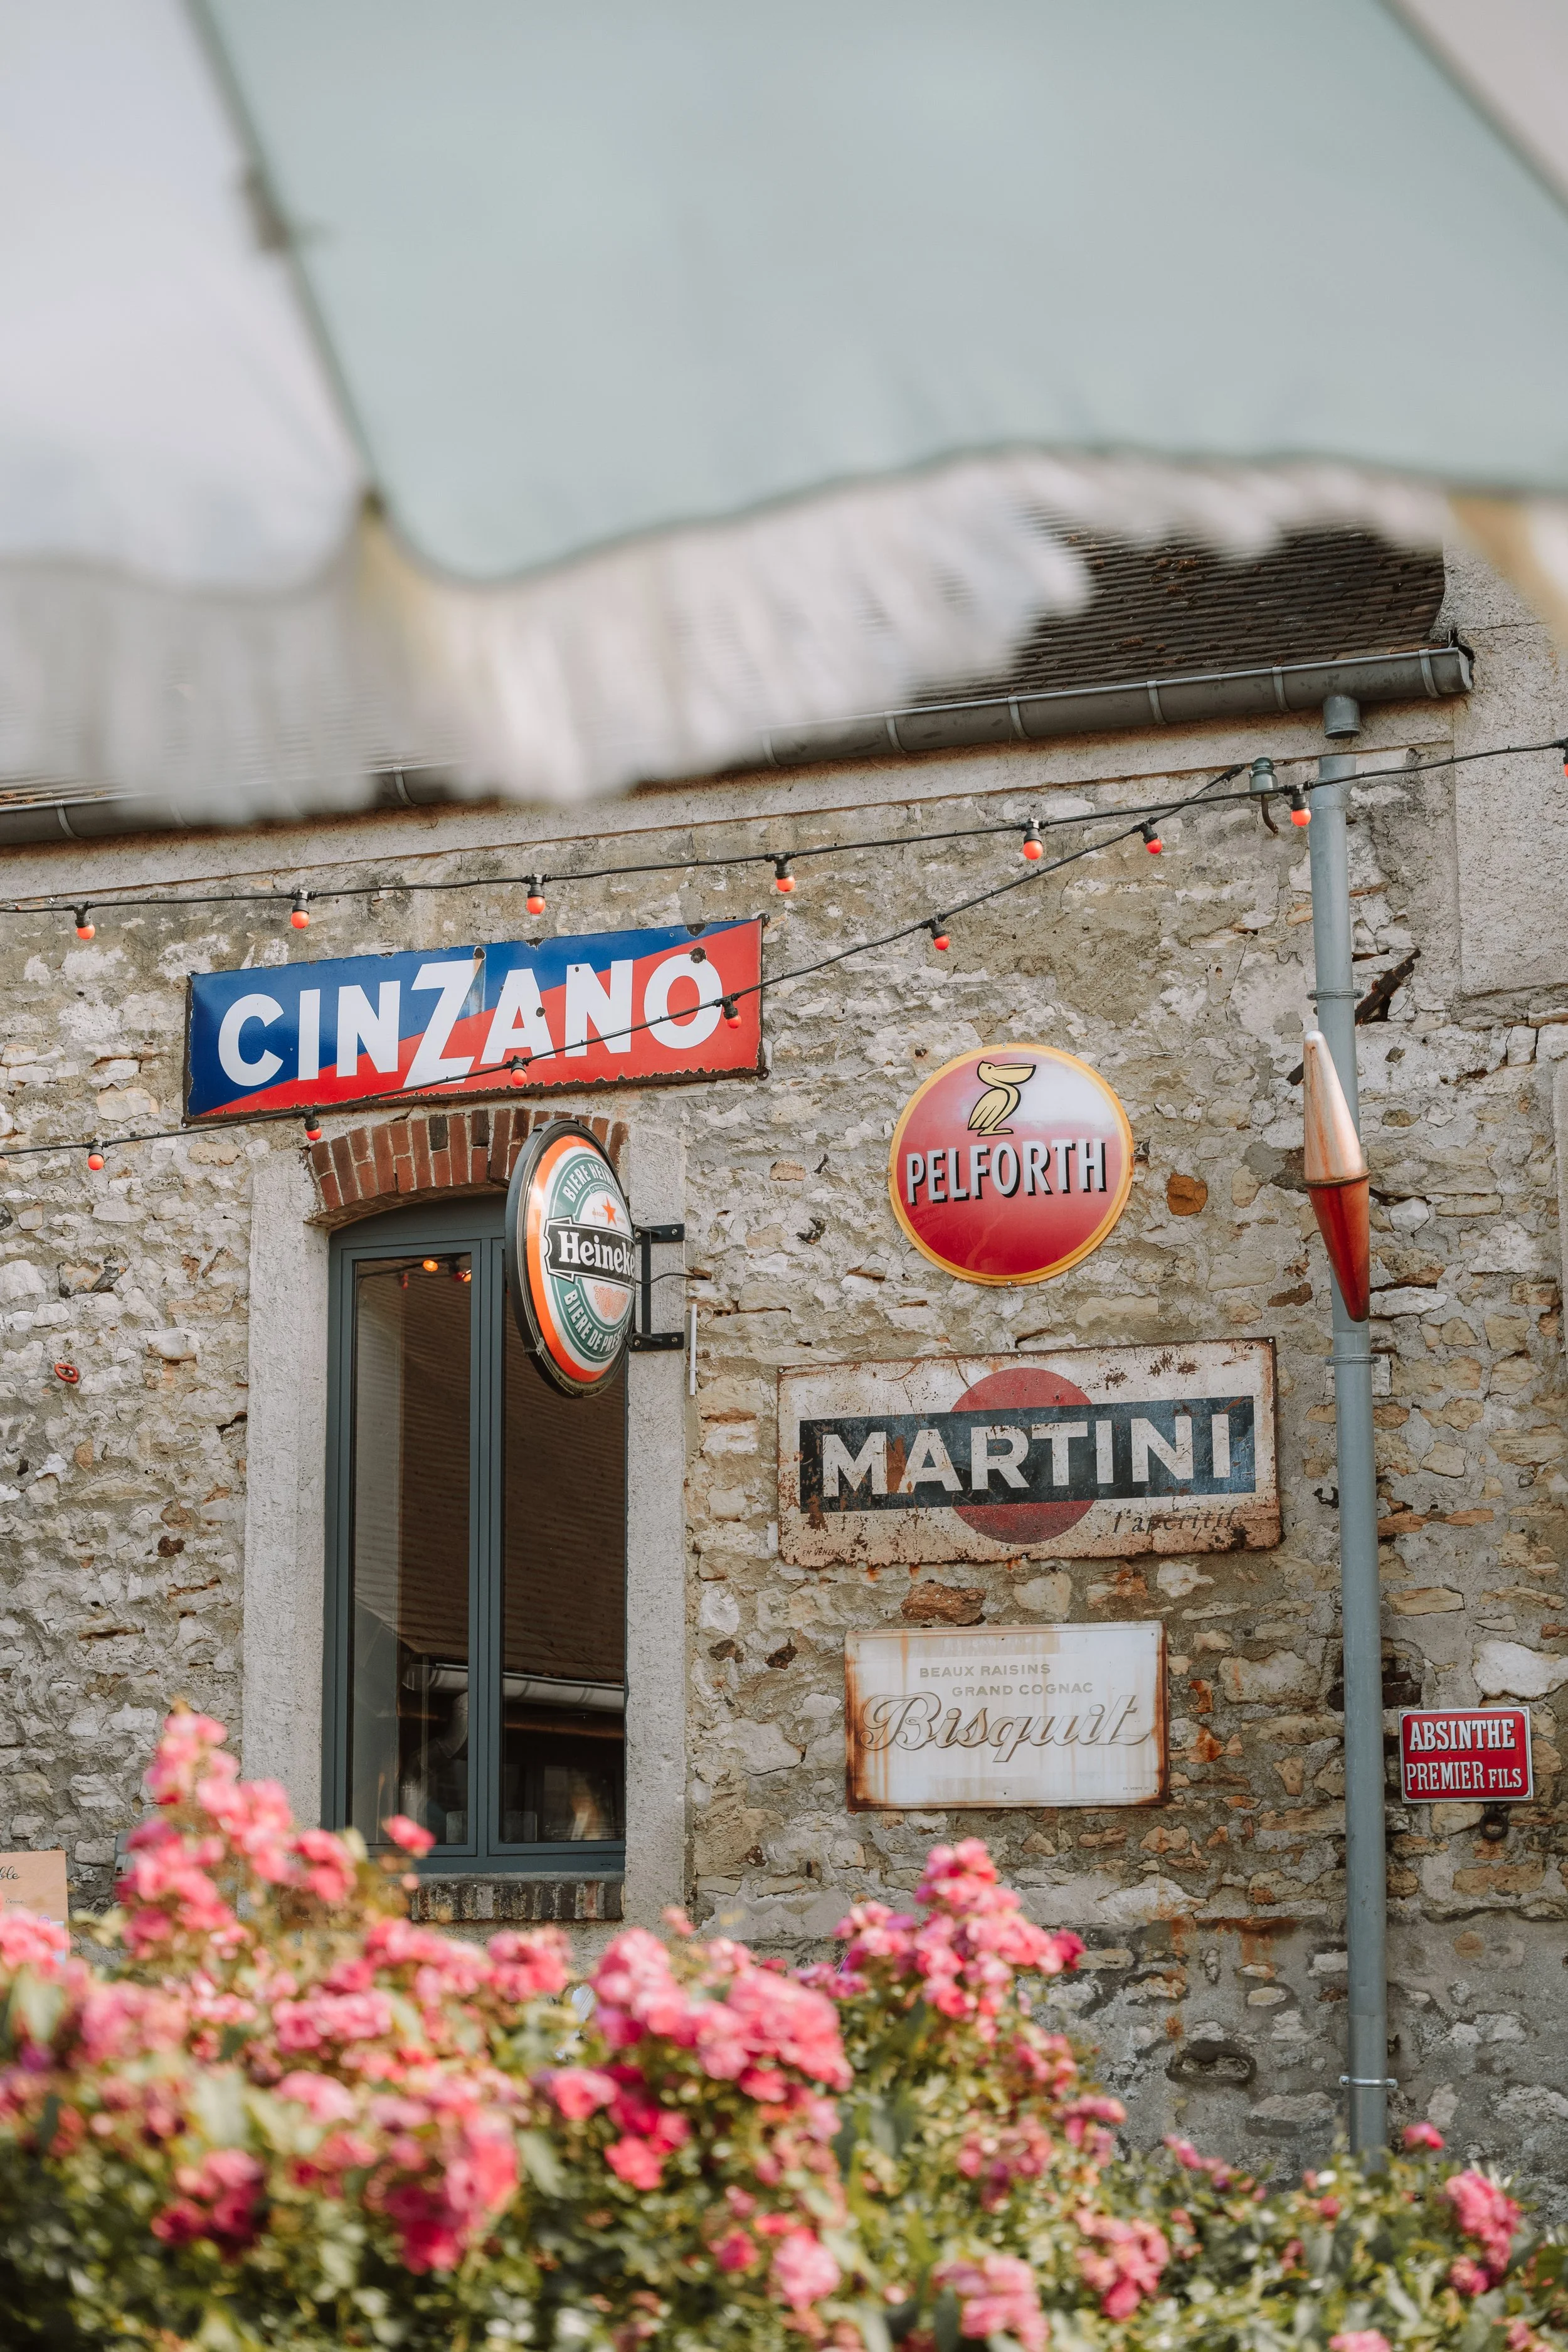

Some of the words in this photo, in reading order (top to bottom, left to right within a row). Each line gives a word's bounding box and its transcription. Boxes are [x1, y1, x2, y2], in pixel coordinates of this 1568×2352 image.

[218, 954, 723, 1088] CINZANO
[563, 1165, 591, 1203] BIERE
[906, 1138, 1107, 1205] PELFORTH
[564, 1290, 593, 1340] BIERE
[587, 1329, 603, 1350] DE
[823, 1414, 1231, 1498] MARTINI
[919, 1666, 975, 1678] BEAUX
[981, 1663, 1051, 1677] RAISINS
[952, 1685, 1013, 1697] GRAND
[1019, 1682, 1093, 1695] COGNAC
[860, 1692, 1150, 1763] Bisquit
[1410, 1719, 1515, 1751] ABSINTHE
[1406, 1761, 1485, 1791] PREMIER
[1488, 1768, 1522, 1789] FILS
